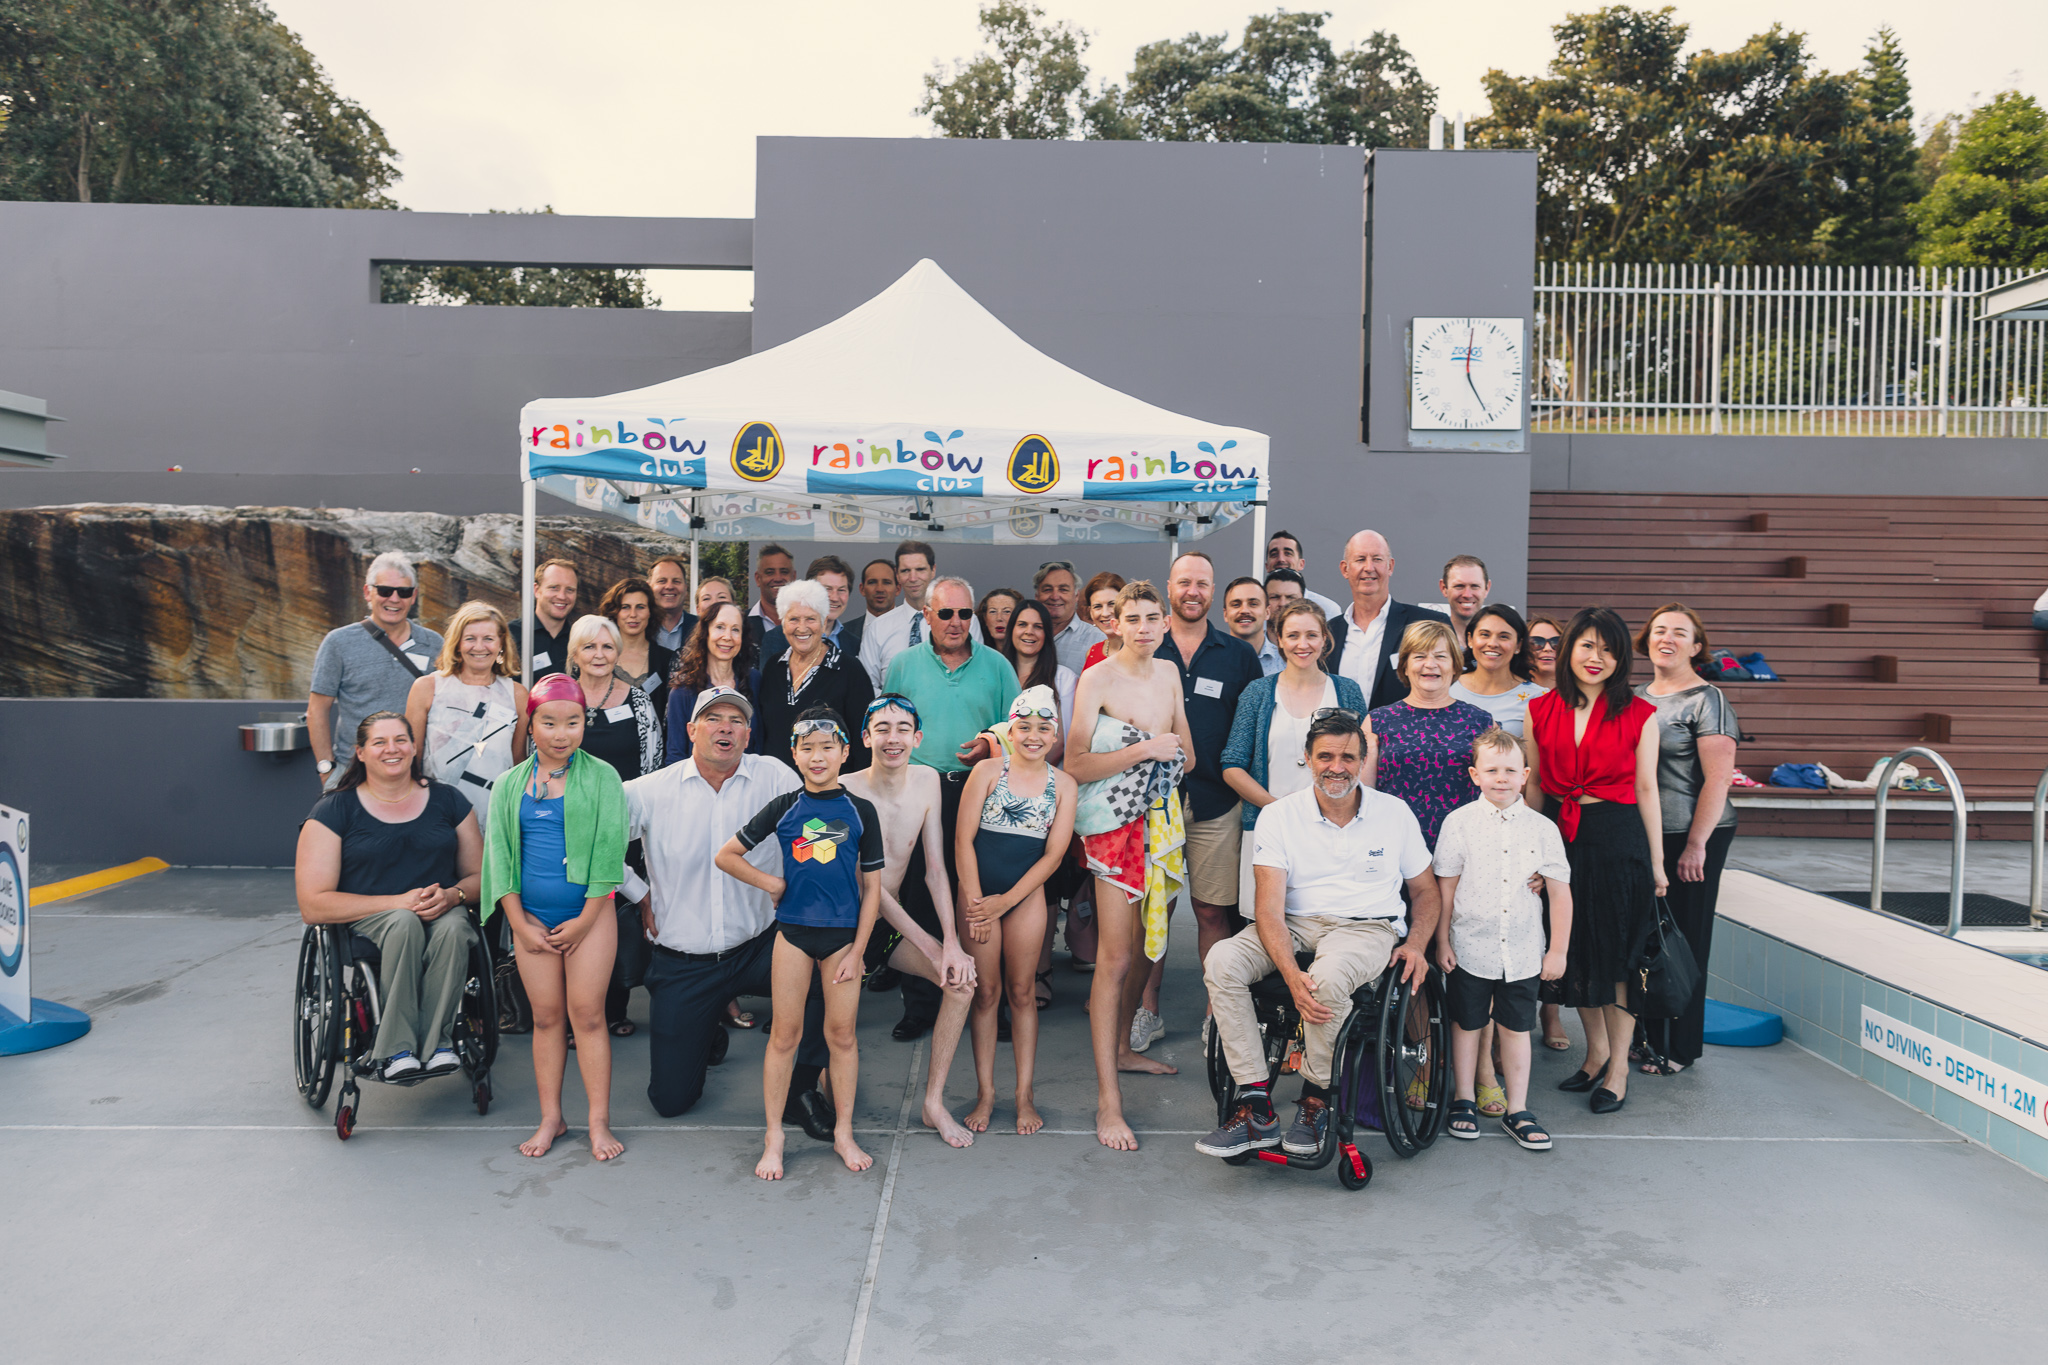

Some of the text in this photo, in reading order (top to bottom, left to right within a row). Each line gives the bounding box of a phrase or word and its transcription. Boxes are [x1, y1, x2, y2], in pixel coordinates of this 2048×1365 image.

[532, 419, 706, 455] rainbow
[640, 457, 695, 478] club
[812, 439, 983, 474] rainbow
[1088, 450, 1256, 481] rainbow
[916, 475, 973, 492] club
[1191, 480, 1245, 493] club
[1865, 1018, 1883, 1043] NO
[1887, 1029, 1932, 1067] DIVING
[1945, 1055, 1995, 1098] DEPTH
[2001, 1082, 2036, 1118] 1.2M
